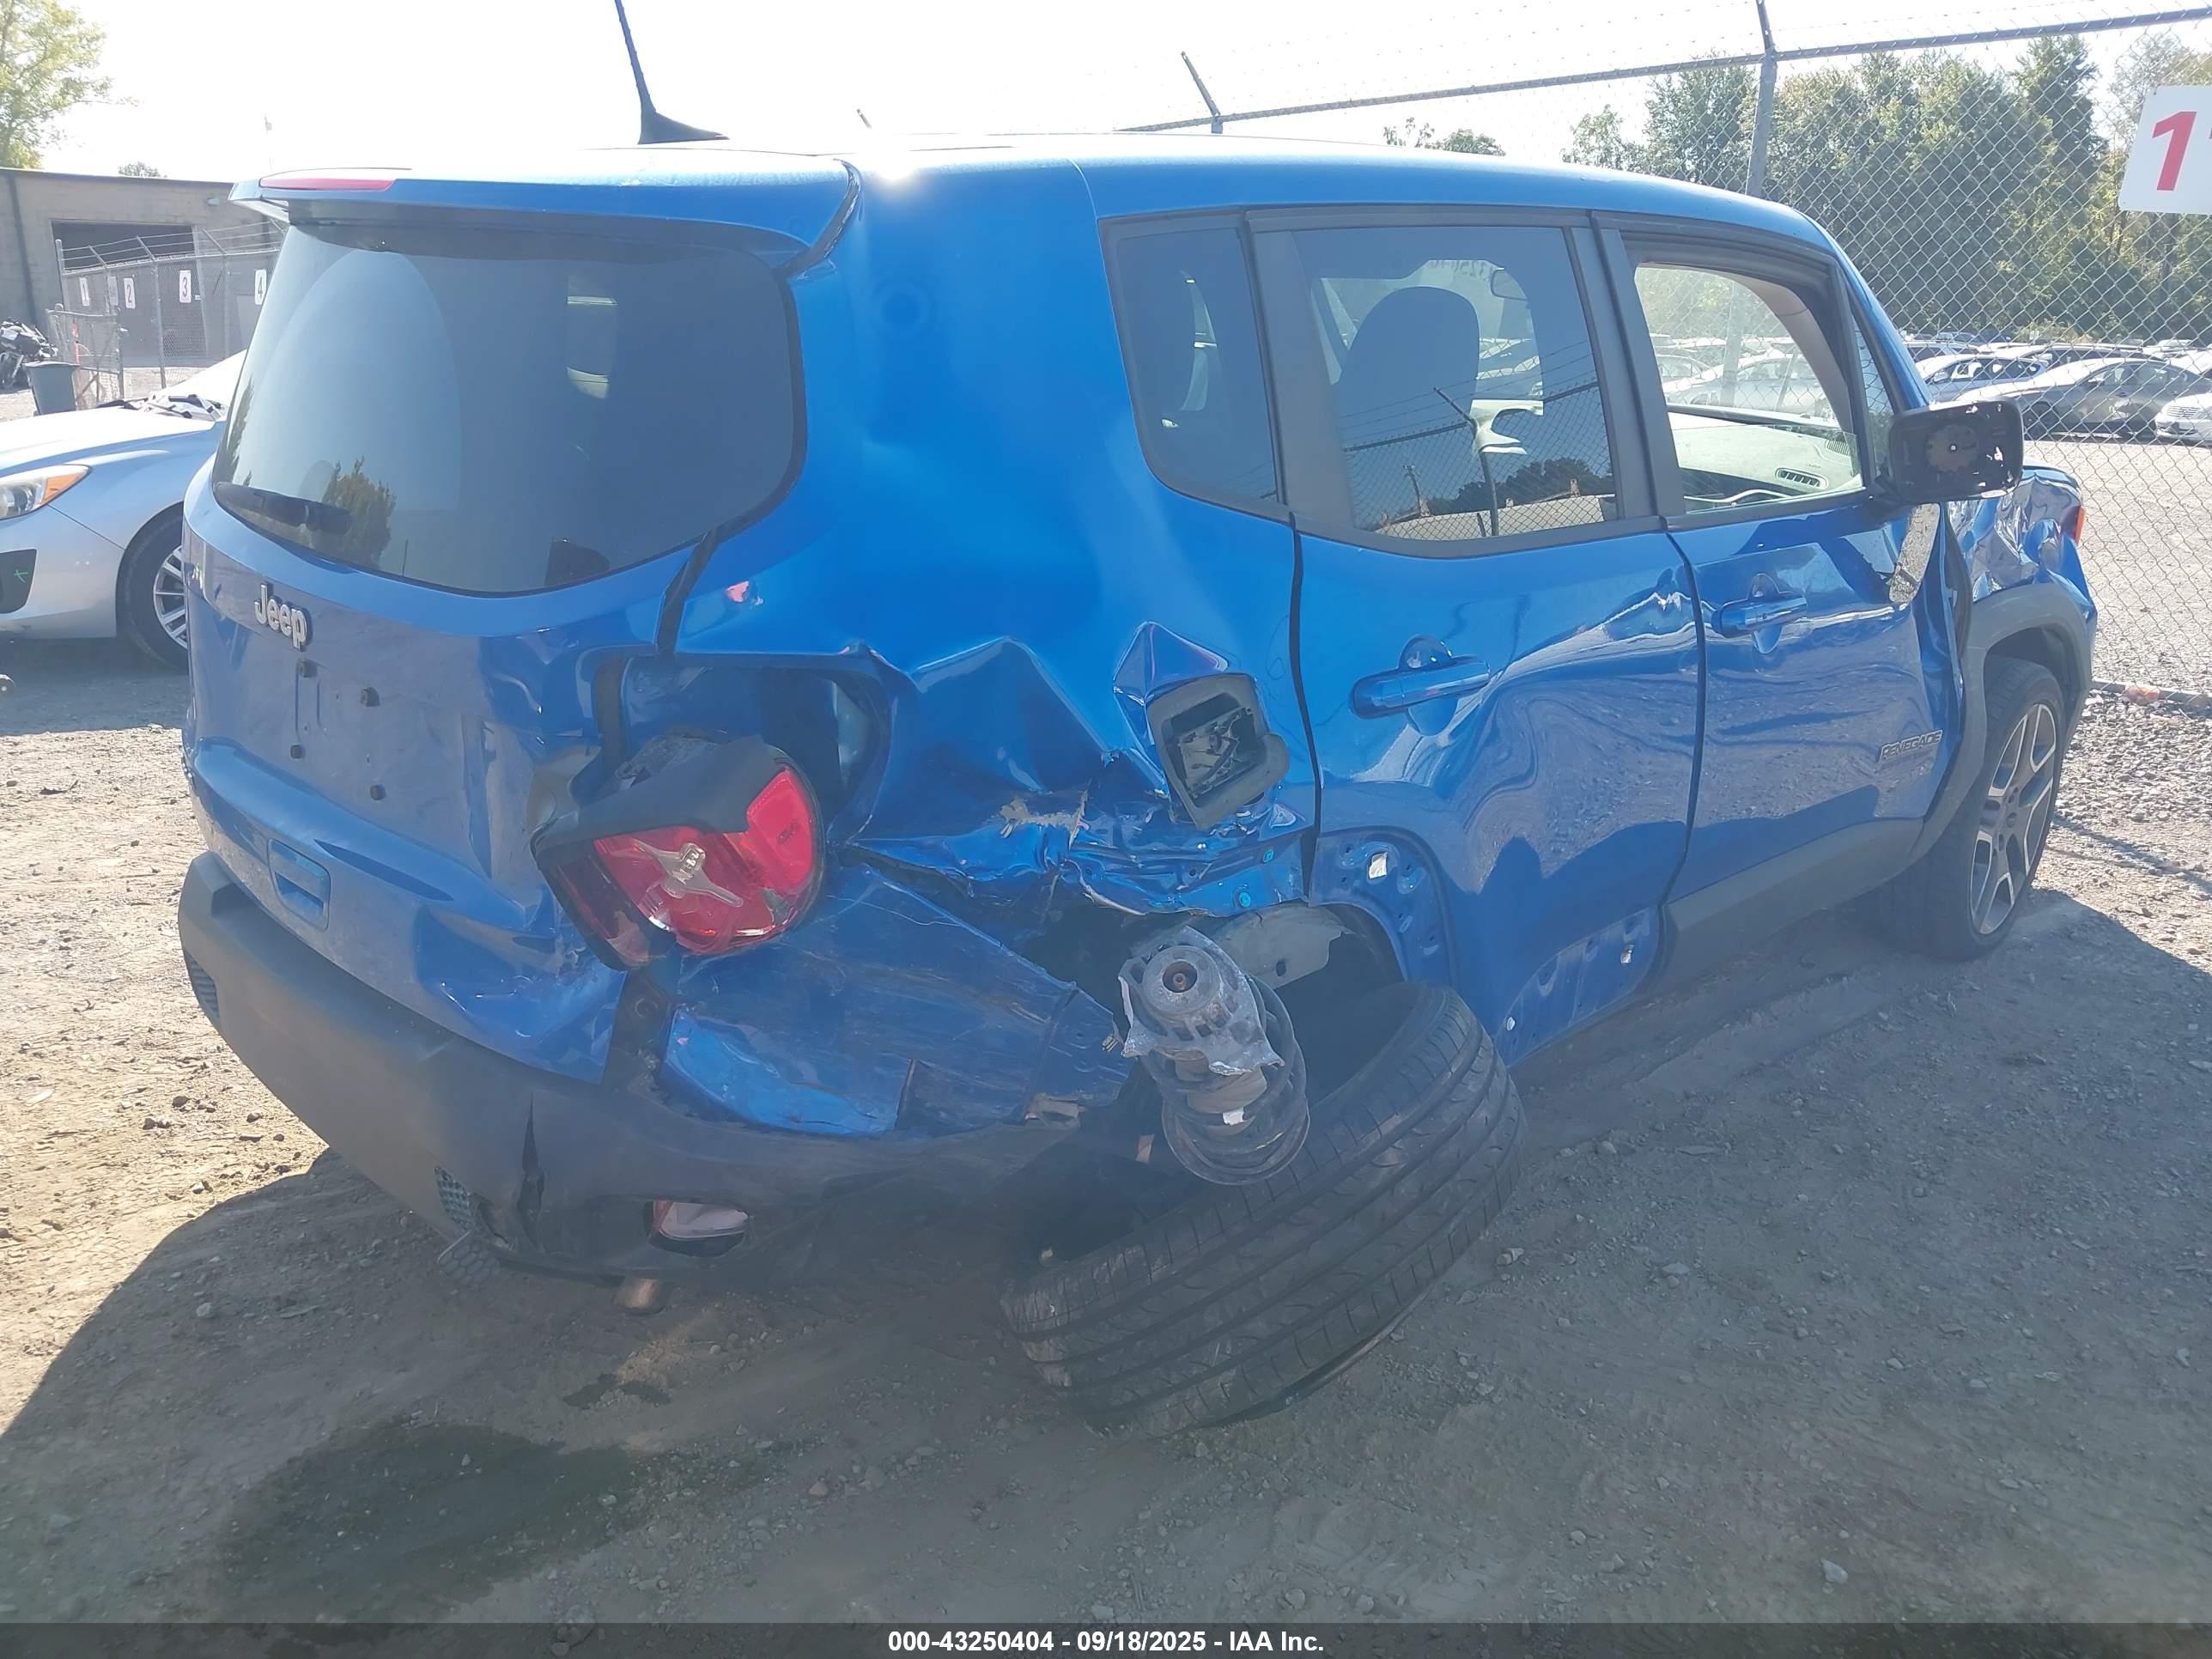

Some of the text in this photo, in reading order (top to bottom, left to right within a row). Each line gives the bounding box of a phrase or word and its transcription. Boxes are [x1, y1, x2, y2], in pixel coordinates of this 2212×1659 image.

[2152, 111, 2212, 191] 1
[126, 284, 132, 303] 2
[182, 276, 188, 297] 3
[258, 276, 264, 299] 4
[253, 583, 307, 650] Jeep
[1881, 729, 1943, 760] RENEGADE
